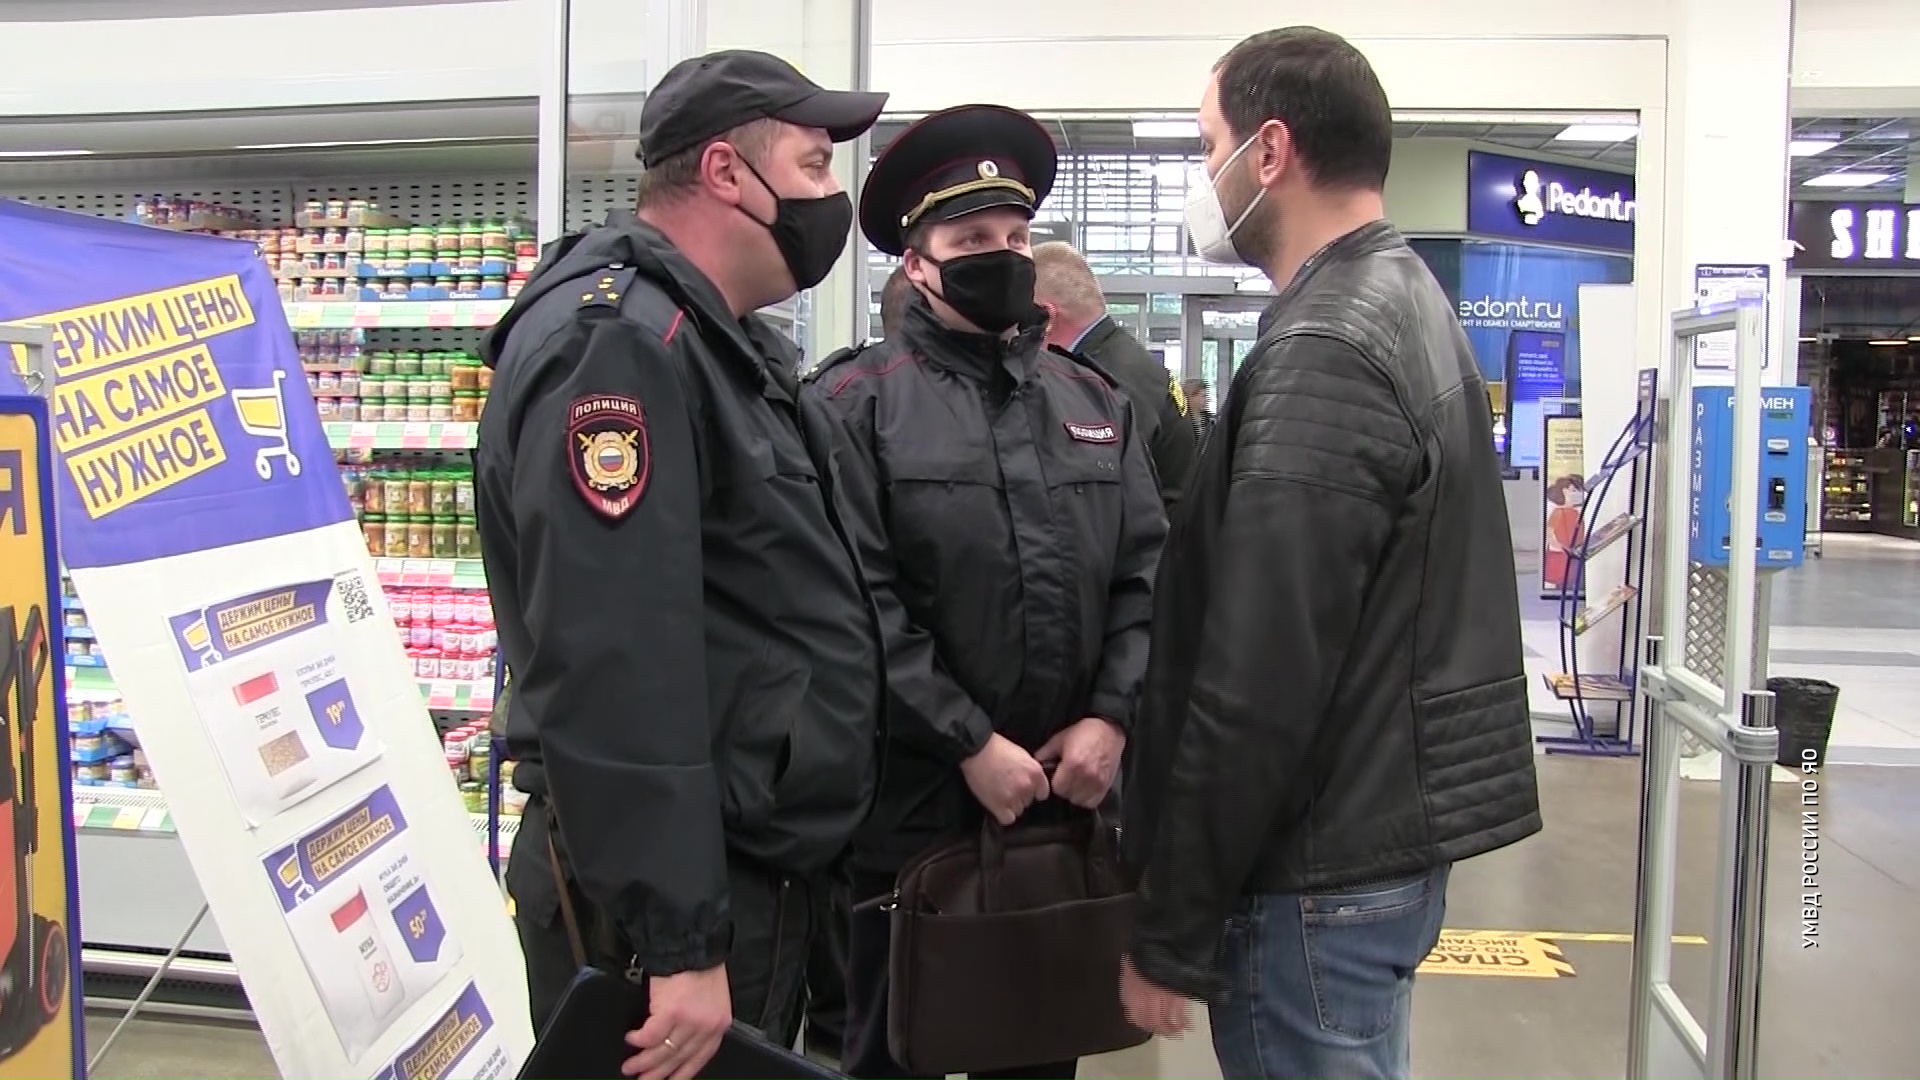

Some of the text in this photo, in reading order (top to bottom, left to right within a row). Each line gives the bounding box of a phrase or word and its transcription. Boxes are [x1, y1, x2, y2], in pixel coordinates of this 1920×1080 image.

[163, 283, 247, 341] ЦЕНЫ
[55, 353, 218, 443] НА САМОЕ
[575, 399, 638, 418] ПОЛИЦИЯ
[1727, 396, 1794, 410] РМЕН
[76, 418, 217, 508] НУЖНОЕ
[601, 496, 630, 516] МВД
[220, 594, 293, 629] ДЕРЖИМ ЦЕНЫ
[226, 606, 314, 647] НА САМОЕ НУЖНОЕ
[309, 811, 369, 859] ДЕРЖИМ ЦЕНЫ
[316, 860, 329, 877] НА
[327, 841, 360, 868] САМОЕ
[359, 817, 393, 850] НУЖНОЕ
